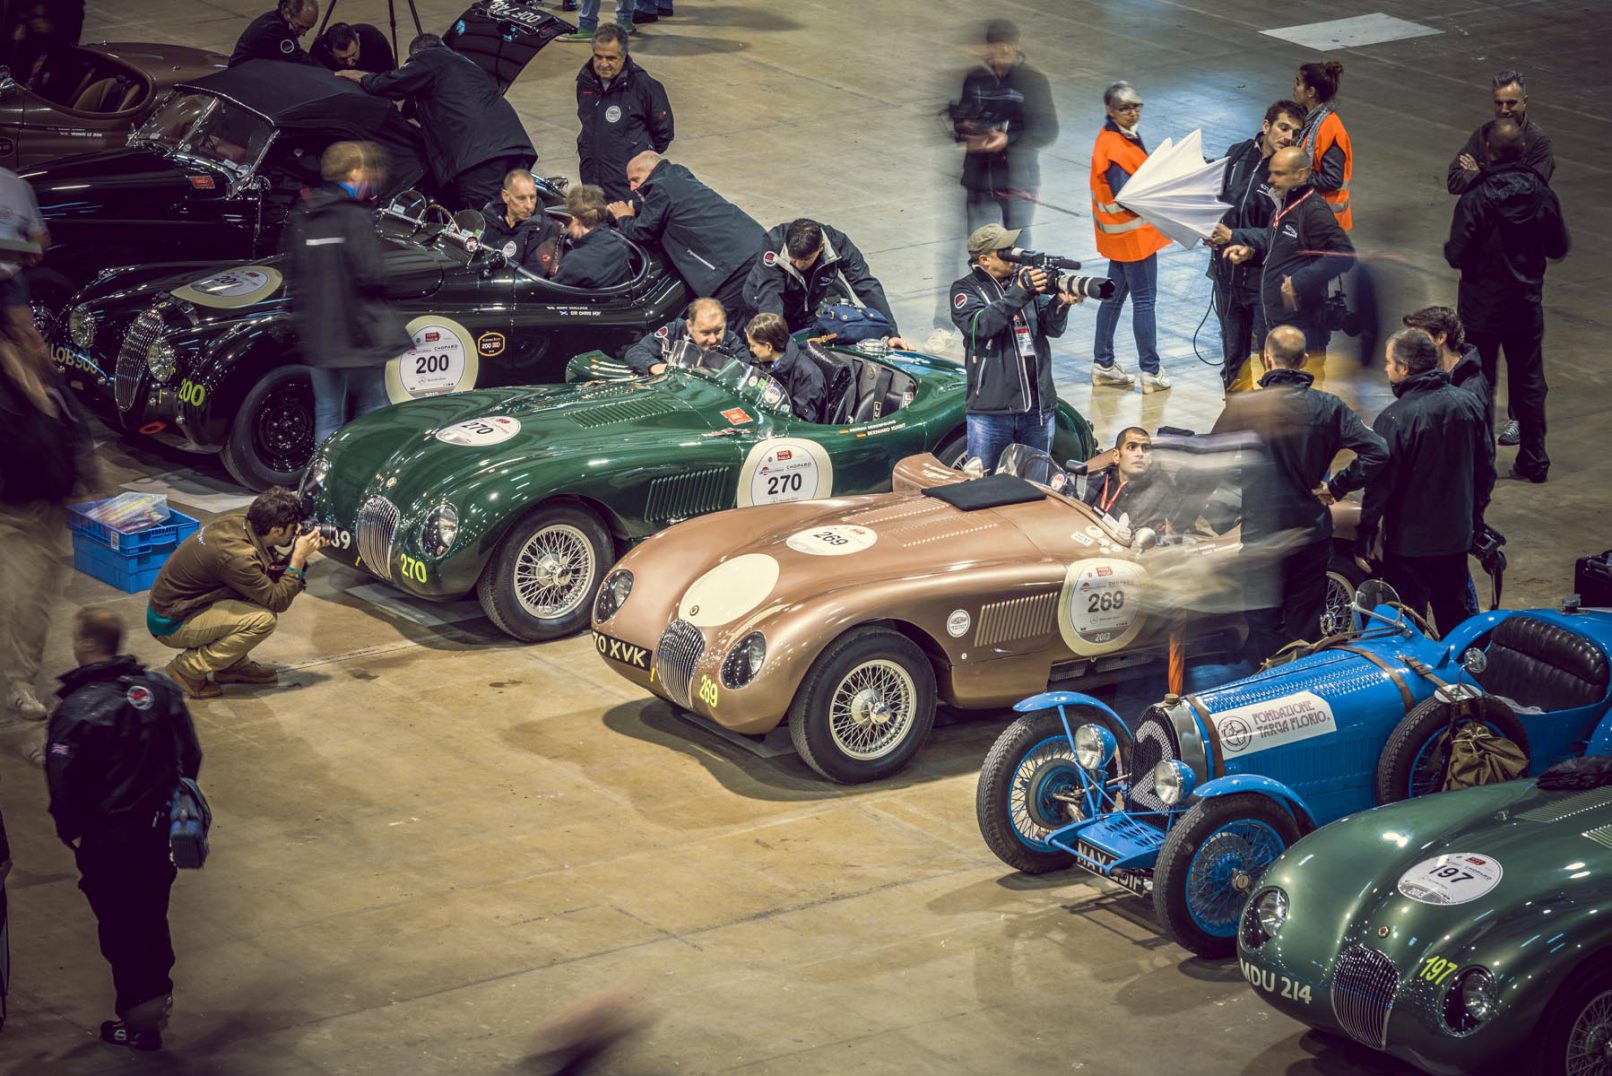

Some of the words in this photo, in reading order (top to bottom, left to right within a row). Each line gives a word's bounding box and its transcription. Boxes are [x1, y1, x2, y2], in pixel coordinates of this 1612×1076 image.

[50, 343, 74, 366] LOB
[416, 354, 449, 374] 200
[179, 378, 205, 407] 200
[461, 422, 494, 435] 270
[768, 473, 802, 495] 270
[813, 531, 849, 546] 269
[400, 553, 427, 584] 270
[1088, 590, 1125, 613] 269
[1095, 632, 1111, 642] 2013
[609, 638, 647, 668] XVK
[699, 674, 718, 708] 269
[1252, 700, 1315, 725] FONDAZIONE
[1256, 720, 1290, 739] TARGA
[1428, 864, 1474, 883] 197
[1240, 957, 1276, 992] MDU
[1280, 976, 1313, 1004] 214
[1418, 955, 1456, 985] 197
